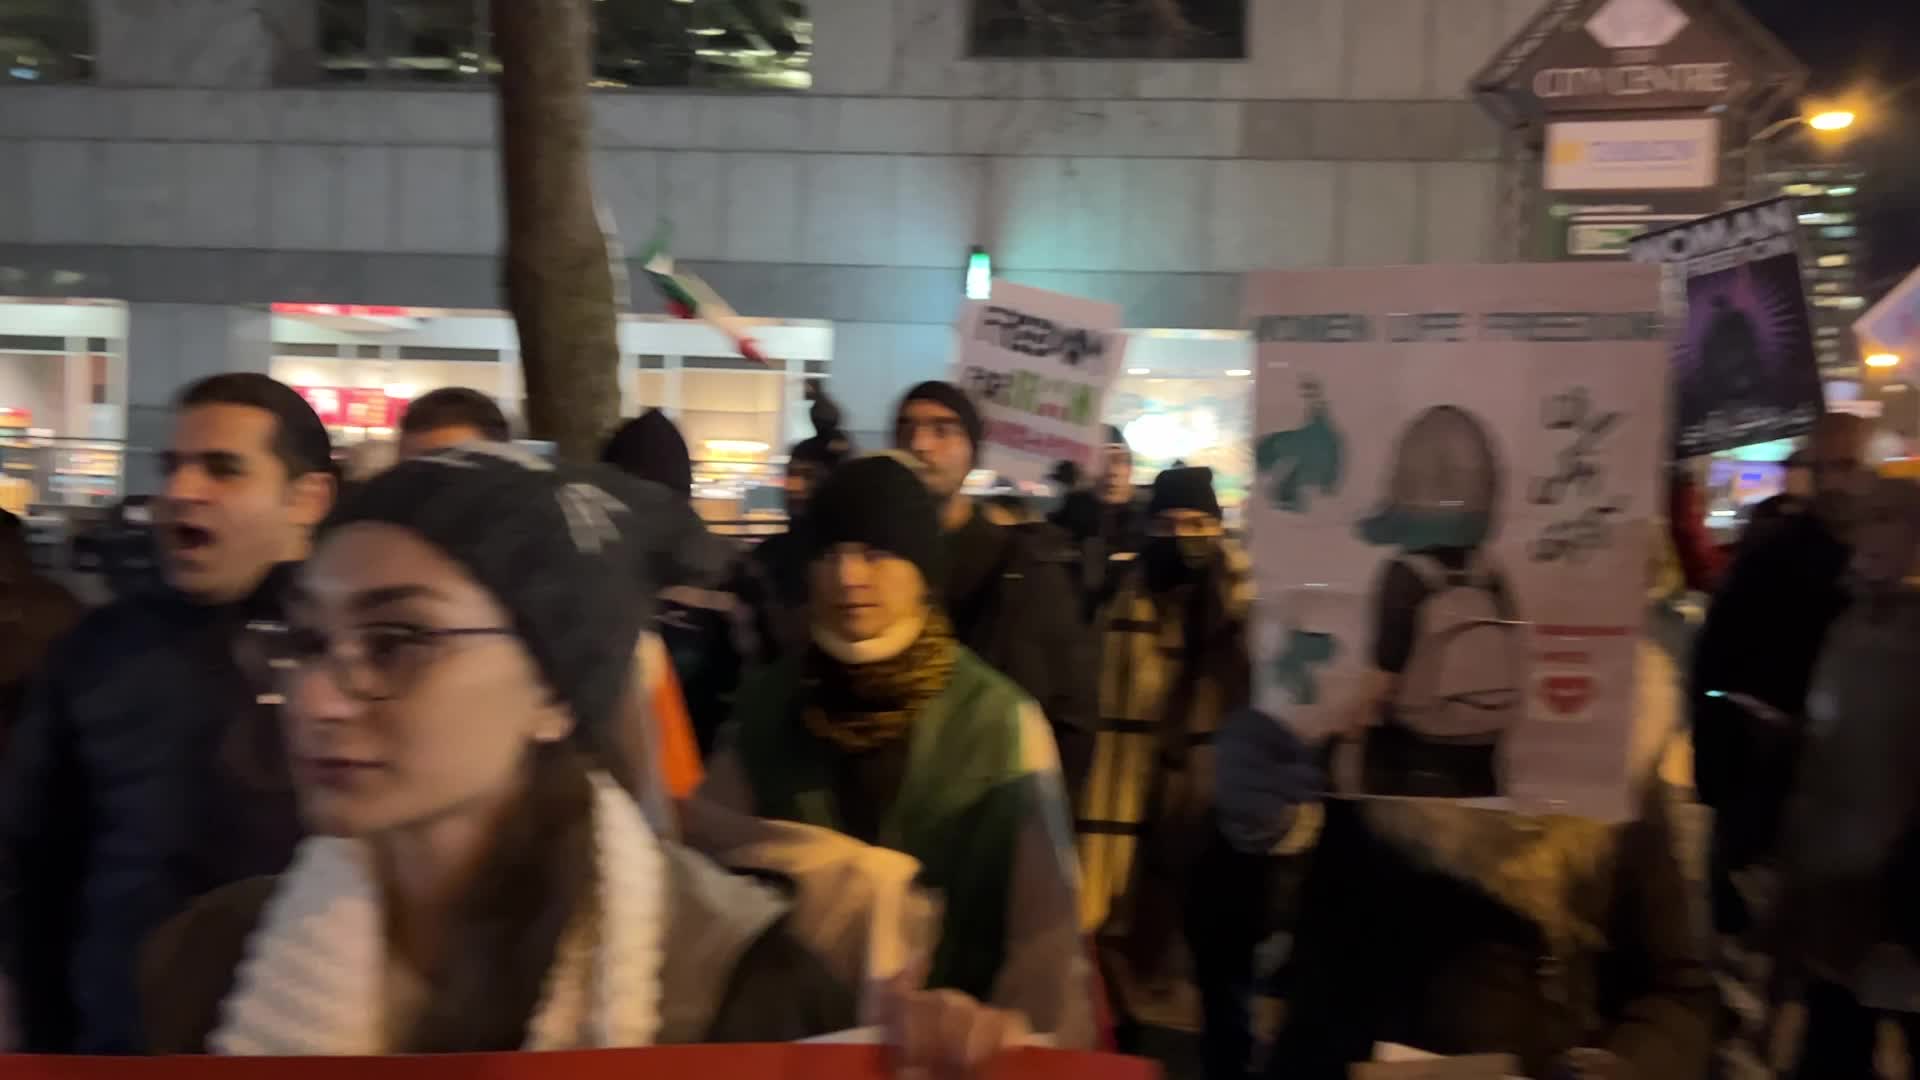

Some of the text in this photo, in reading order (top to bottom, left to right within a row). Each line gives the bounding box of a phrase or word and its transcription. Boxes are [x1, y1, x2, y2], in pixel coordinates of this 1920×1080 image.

[1533, 61, 1731, 98] CITY CENTRE
[980, 305, 1106, 366] FREEDOM
[1255, 311, 1659, 343] WOMEN LIFE FREEDOM
